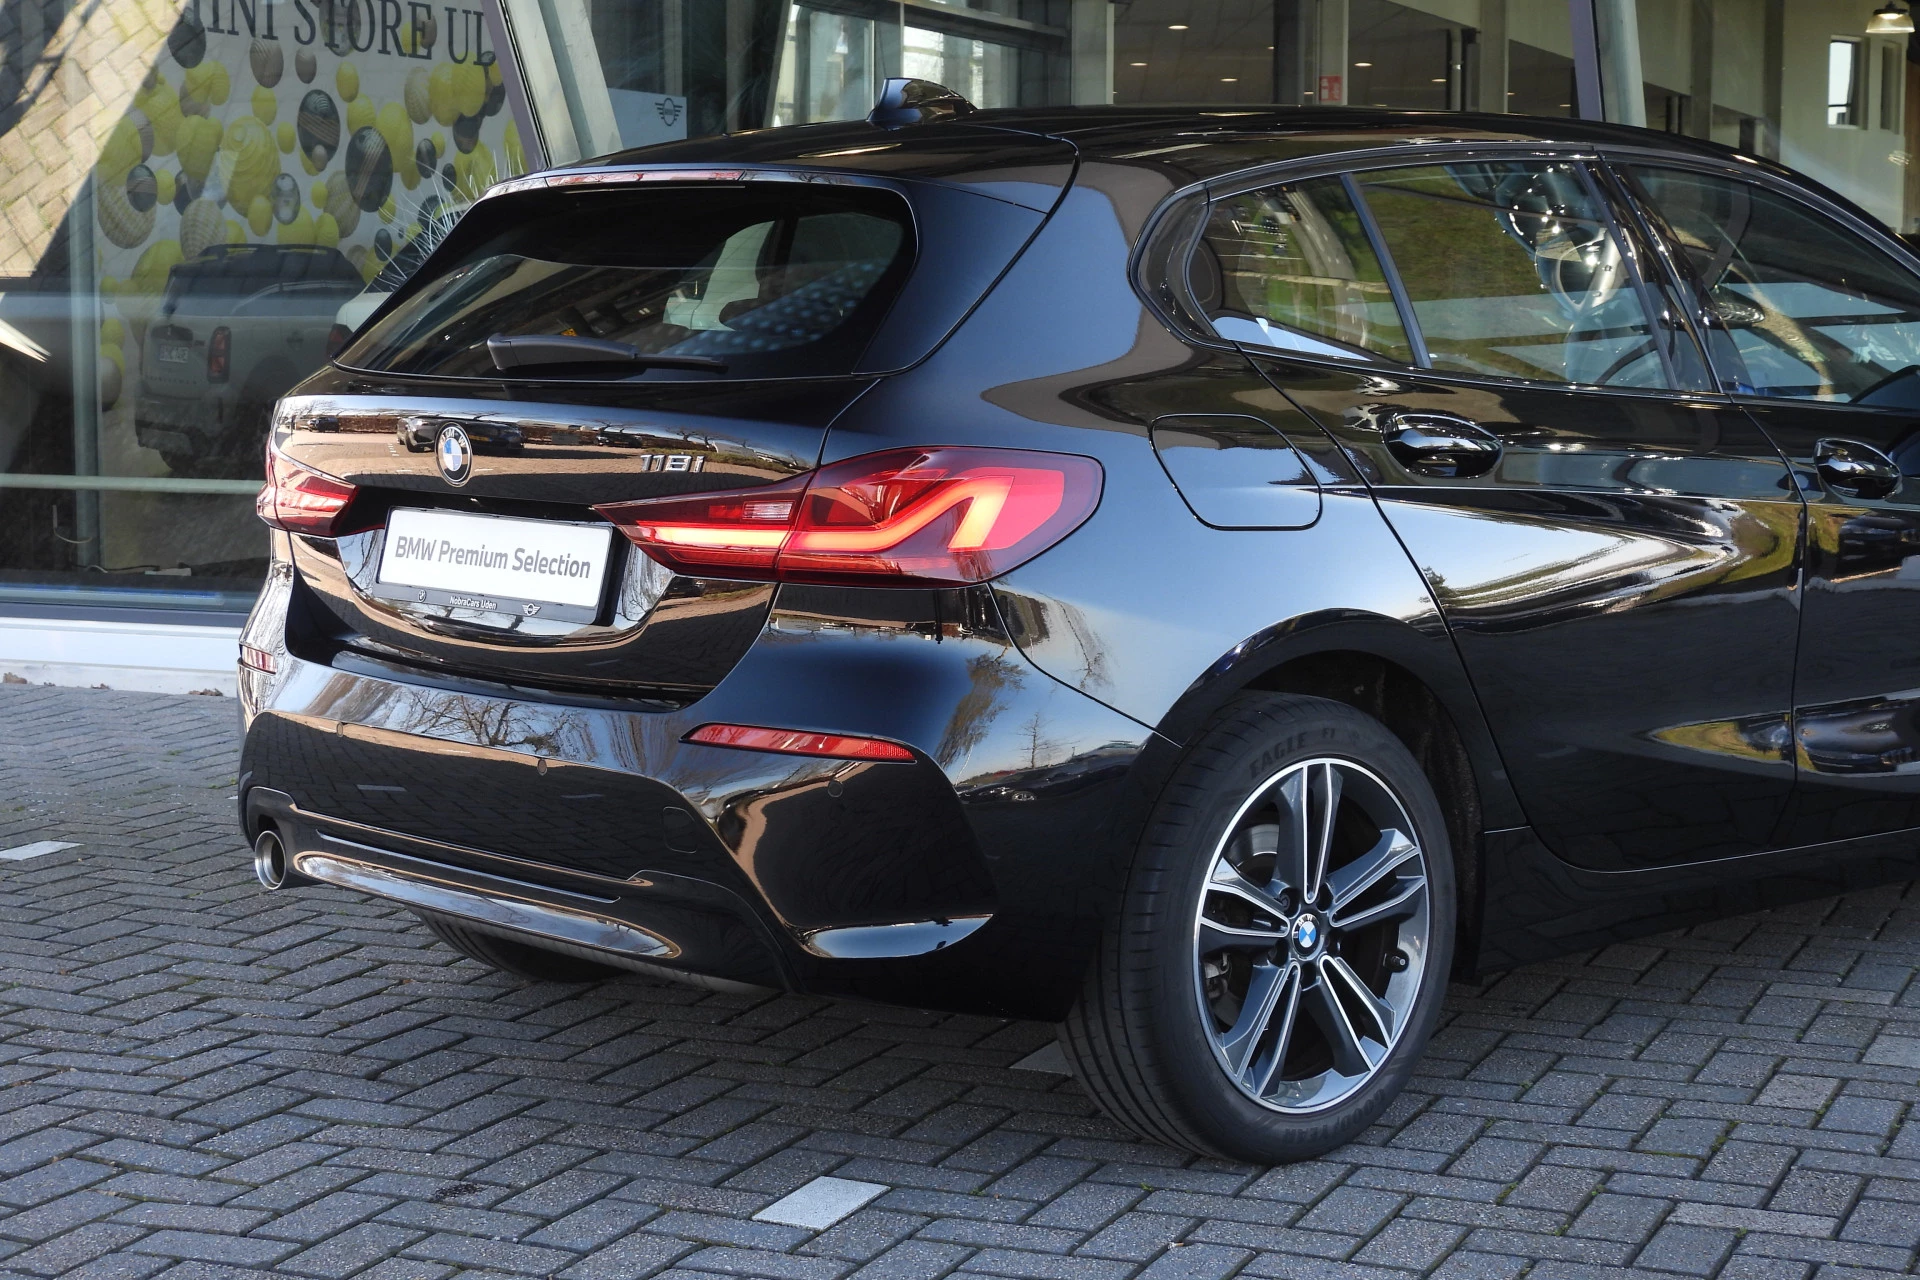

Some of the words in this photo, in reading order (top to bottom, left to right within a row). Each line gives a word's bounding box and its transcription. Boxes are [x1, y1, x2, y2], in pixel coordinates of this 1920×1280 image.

[294, 0, 432, 60] STORE
[640, 454, 705, 473] 118i
[395, 536, 437, 561] BMW
[438, 540, 508, 569] Premium
[512, 547, 591, 579] Selection
[450, 596, 480, 608] NobraCars
[480, 600, 497, 610] Uden
[1249, 731, 1308, 778] EAGLE
